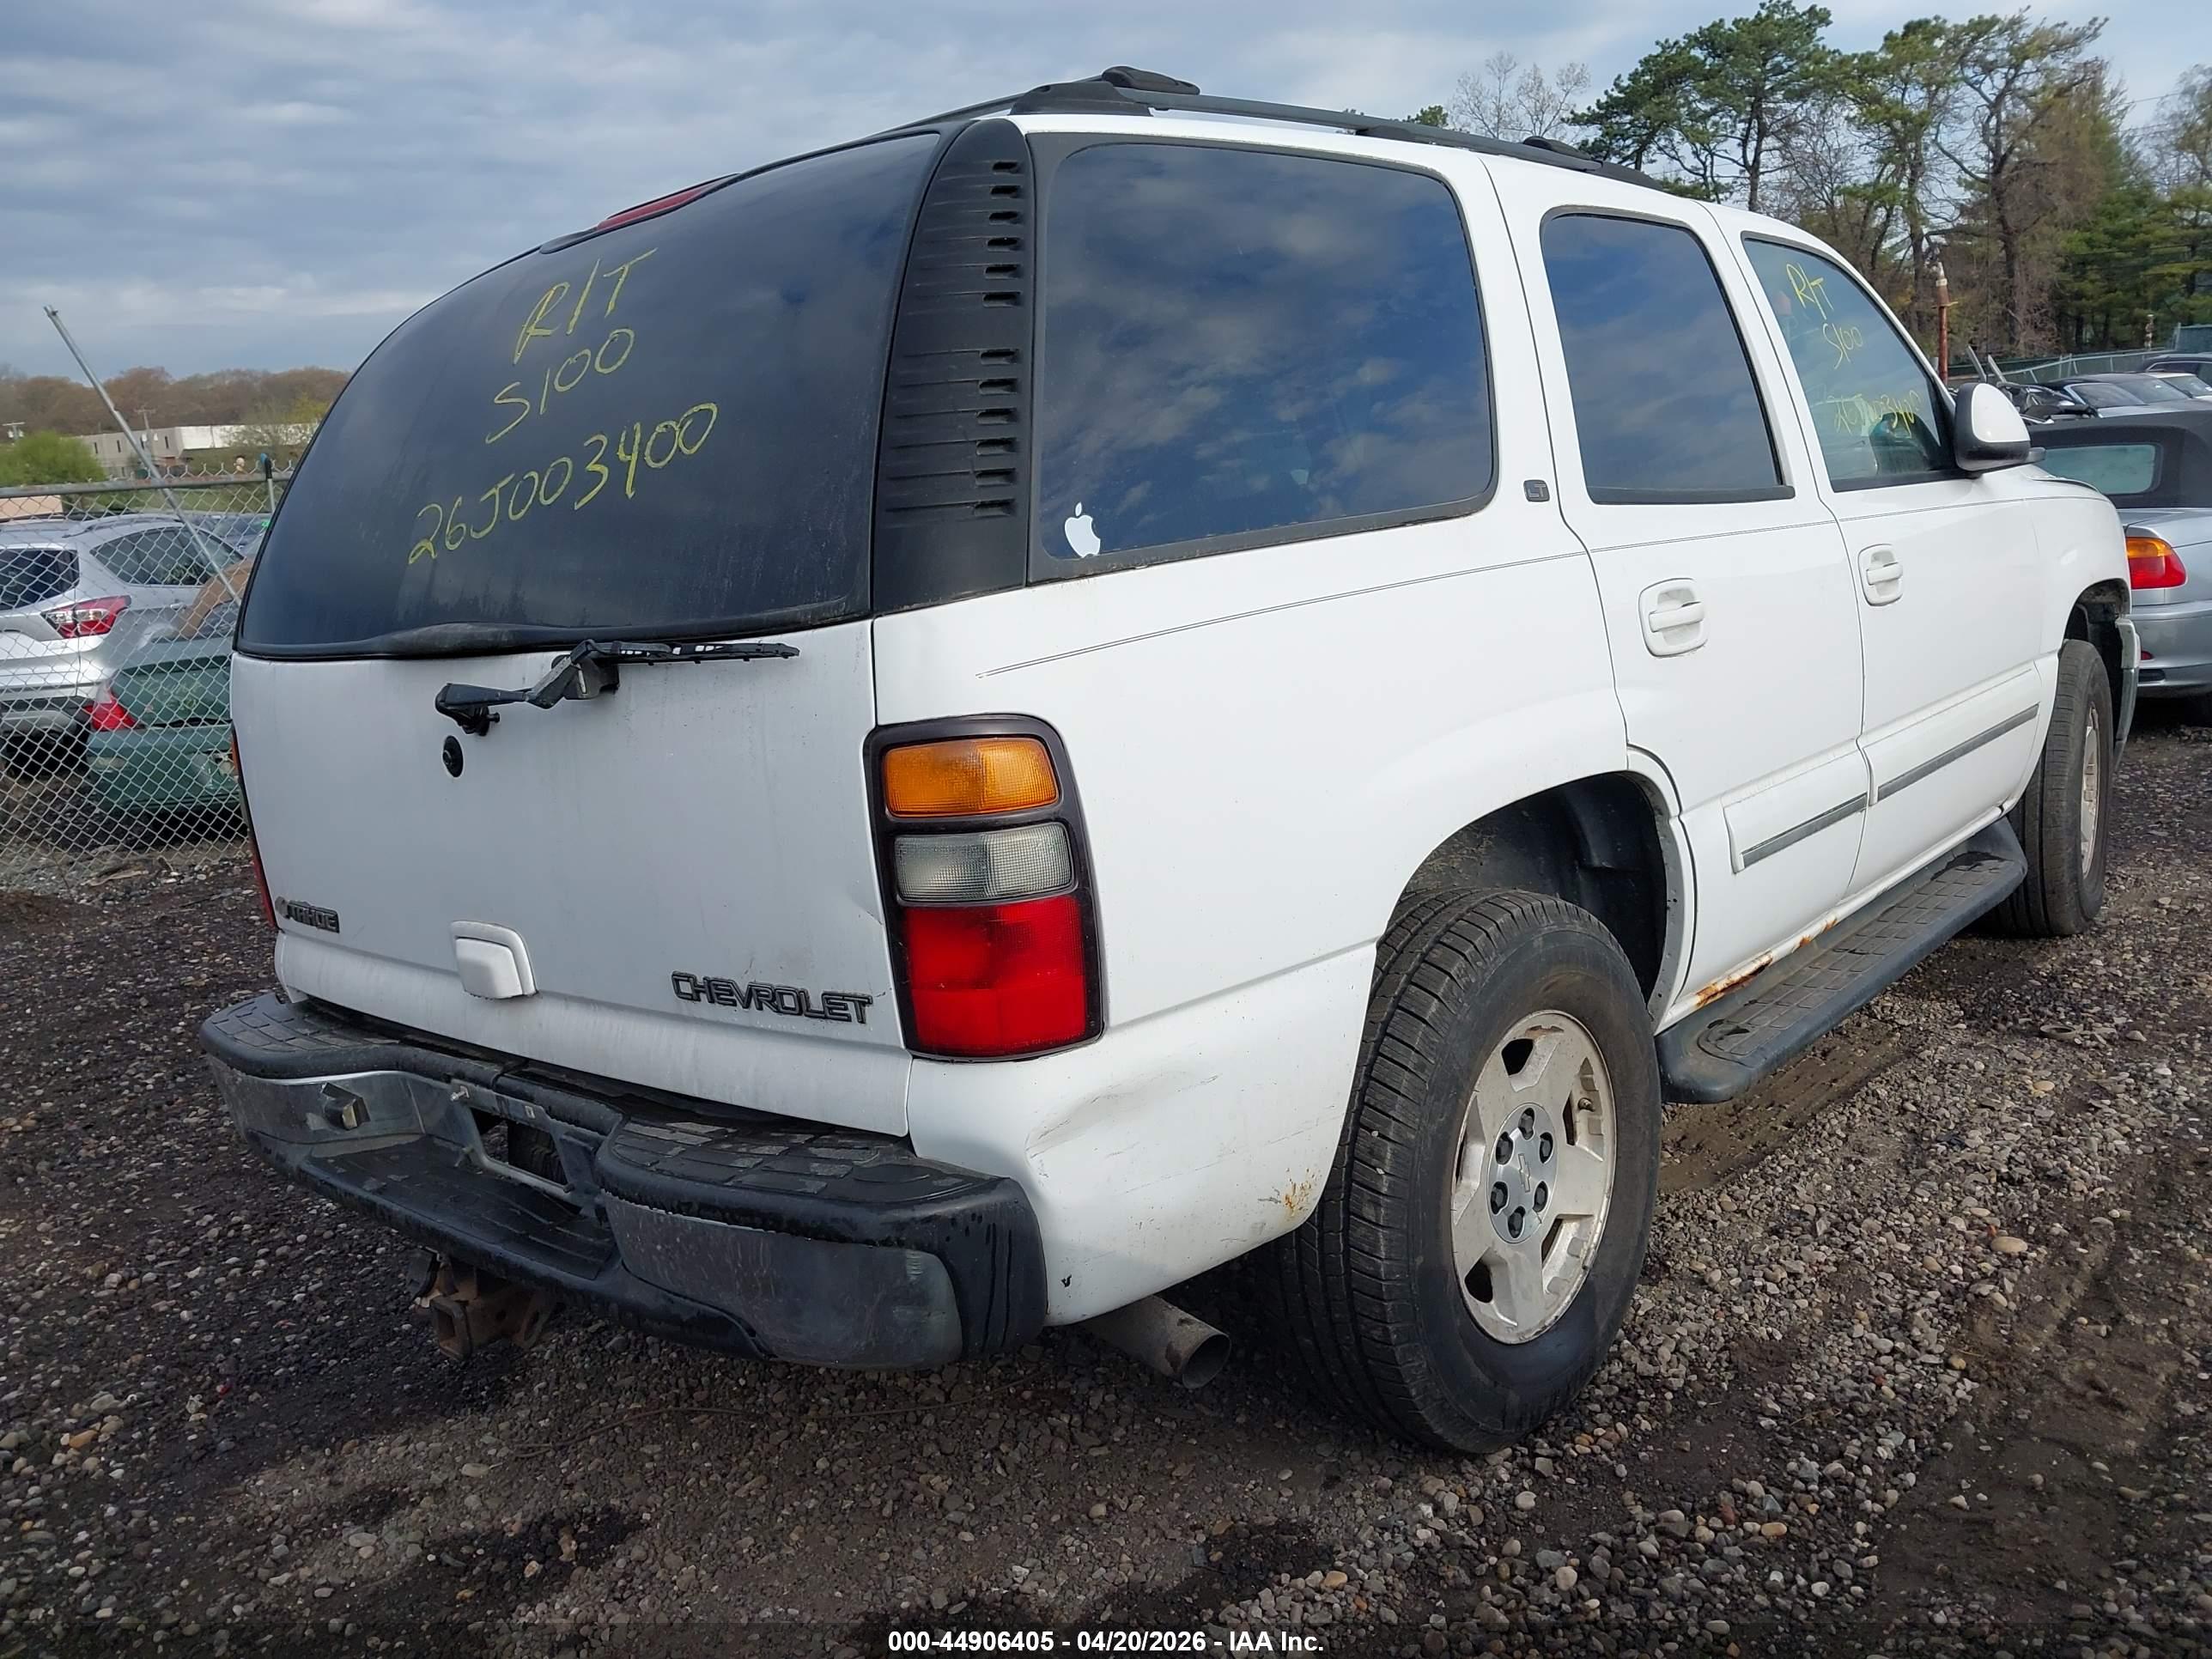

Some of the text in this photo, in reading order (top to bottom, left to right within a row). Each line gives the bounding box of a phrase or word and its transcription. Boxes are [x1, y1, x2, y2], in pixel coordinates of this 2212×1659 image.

[513, 247, 658, 364] R/T
[485, 328, 635, 444] S100
[408, 402, 718, 564] 26J003400
[1528, 483, 1547, 498] LT
[671, 970, 873, 1024] CHEVROLET
